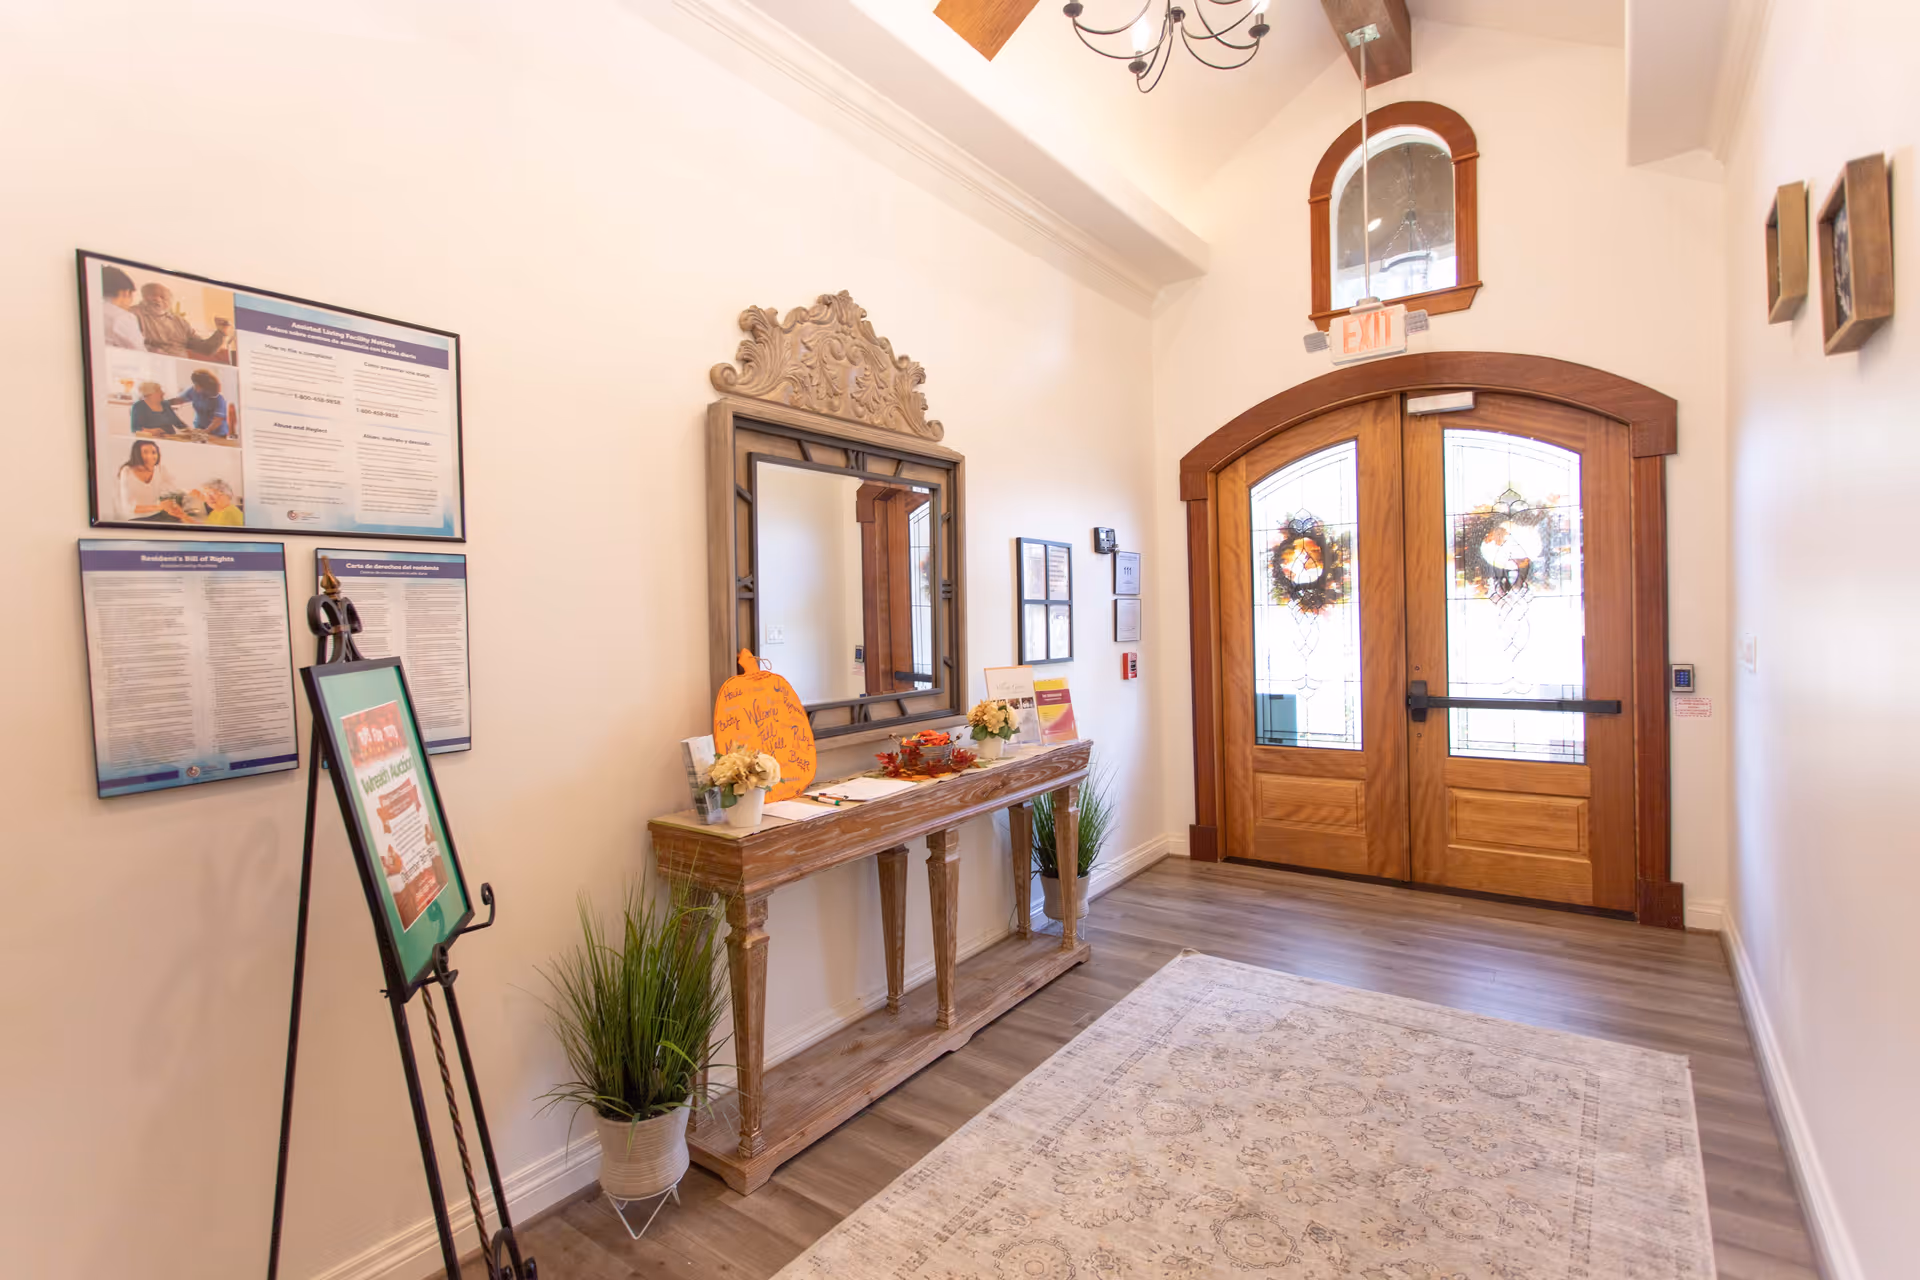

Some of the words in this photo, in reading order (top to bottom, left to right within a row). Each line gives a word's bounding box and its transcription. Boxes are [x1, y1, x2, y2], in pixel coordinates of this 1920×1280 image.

[291, 322, 322, 333] Assisted
[322, 328, 345, 339] Living
[345, 332, 370, 345] Facility
[371, 338, 396, 349] Notices
[1343, 311, 1393, 354] EXIT
[140, 555, 184, 563] Resident's
[209, 555, 235, 563] Rights
[743, 698, 779, 728] Welcome
[361, 767, 391, 795] Wreath
[390, 755, 412, 780] Auction
